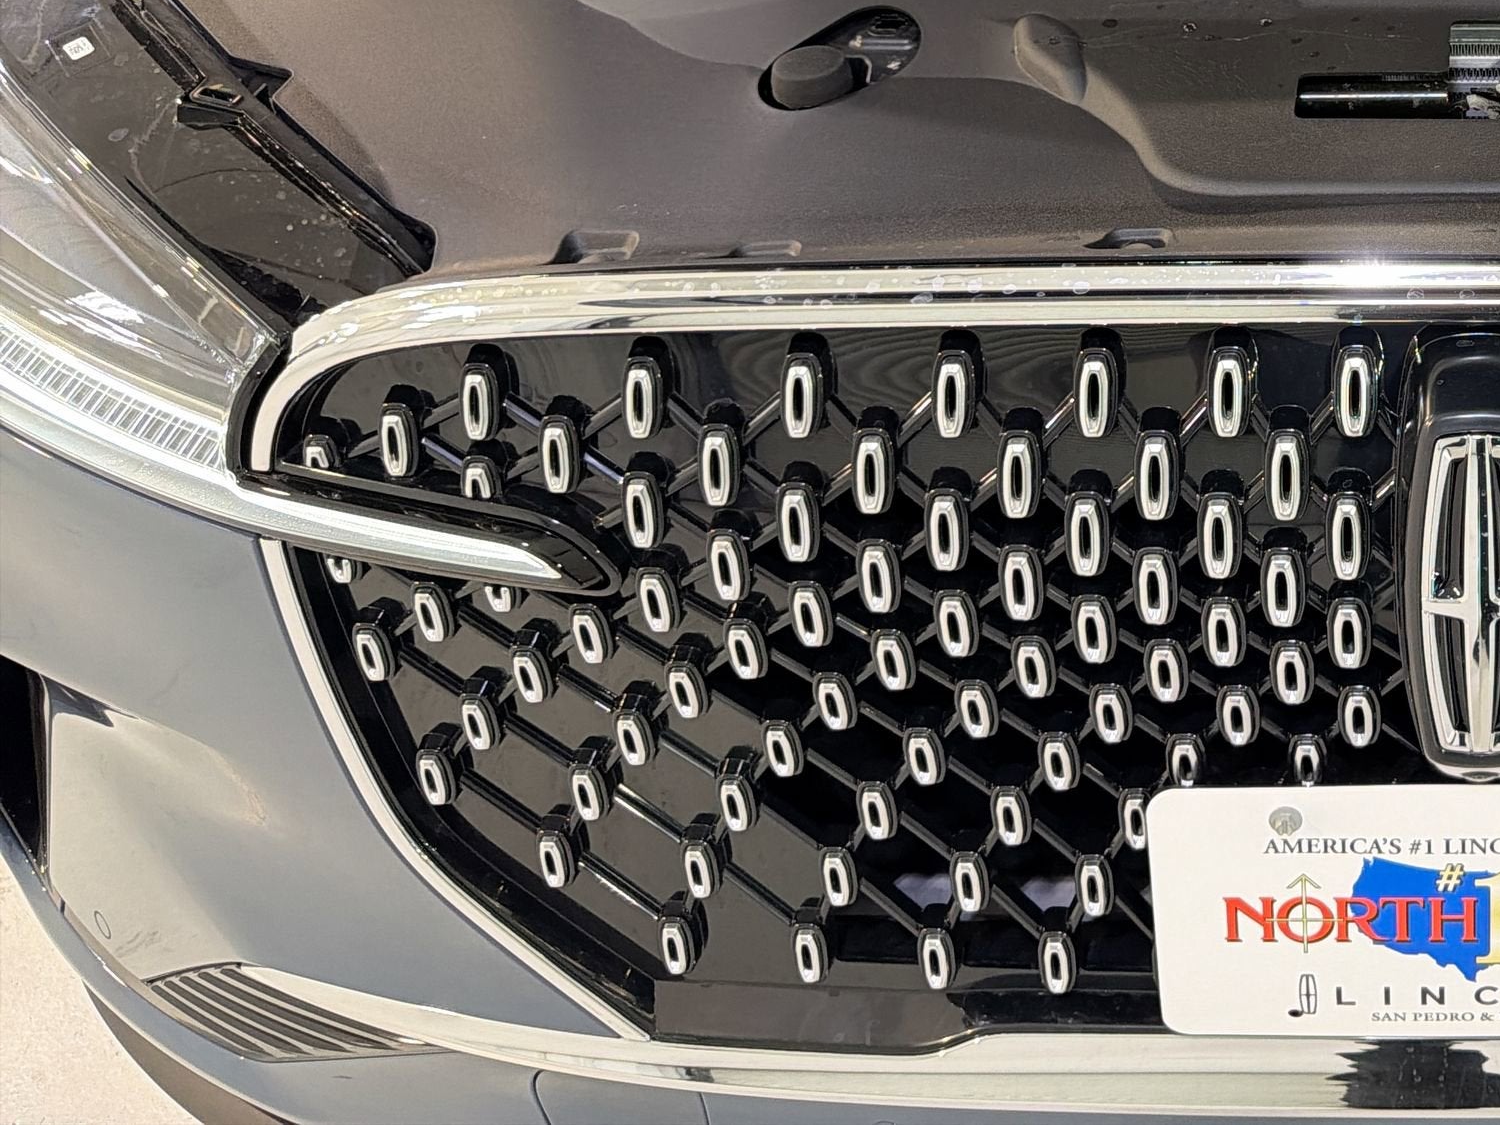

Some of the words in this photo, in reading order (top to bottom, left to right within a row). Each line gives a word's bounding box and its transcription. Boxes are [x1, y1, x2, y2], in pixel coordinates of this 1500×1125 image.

[1263, 837, 1402, 855] AMERICA'S
[1408, 838, 1435, 855] #1
[1222, 896, 1480, 944] NORTH
[1371, 1012, 1406, 1022] SAN
[1412, 1012, 1475, 1022] PEDRO
[1480, 1012, 1495, 1022] &
